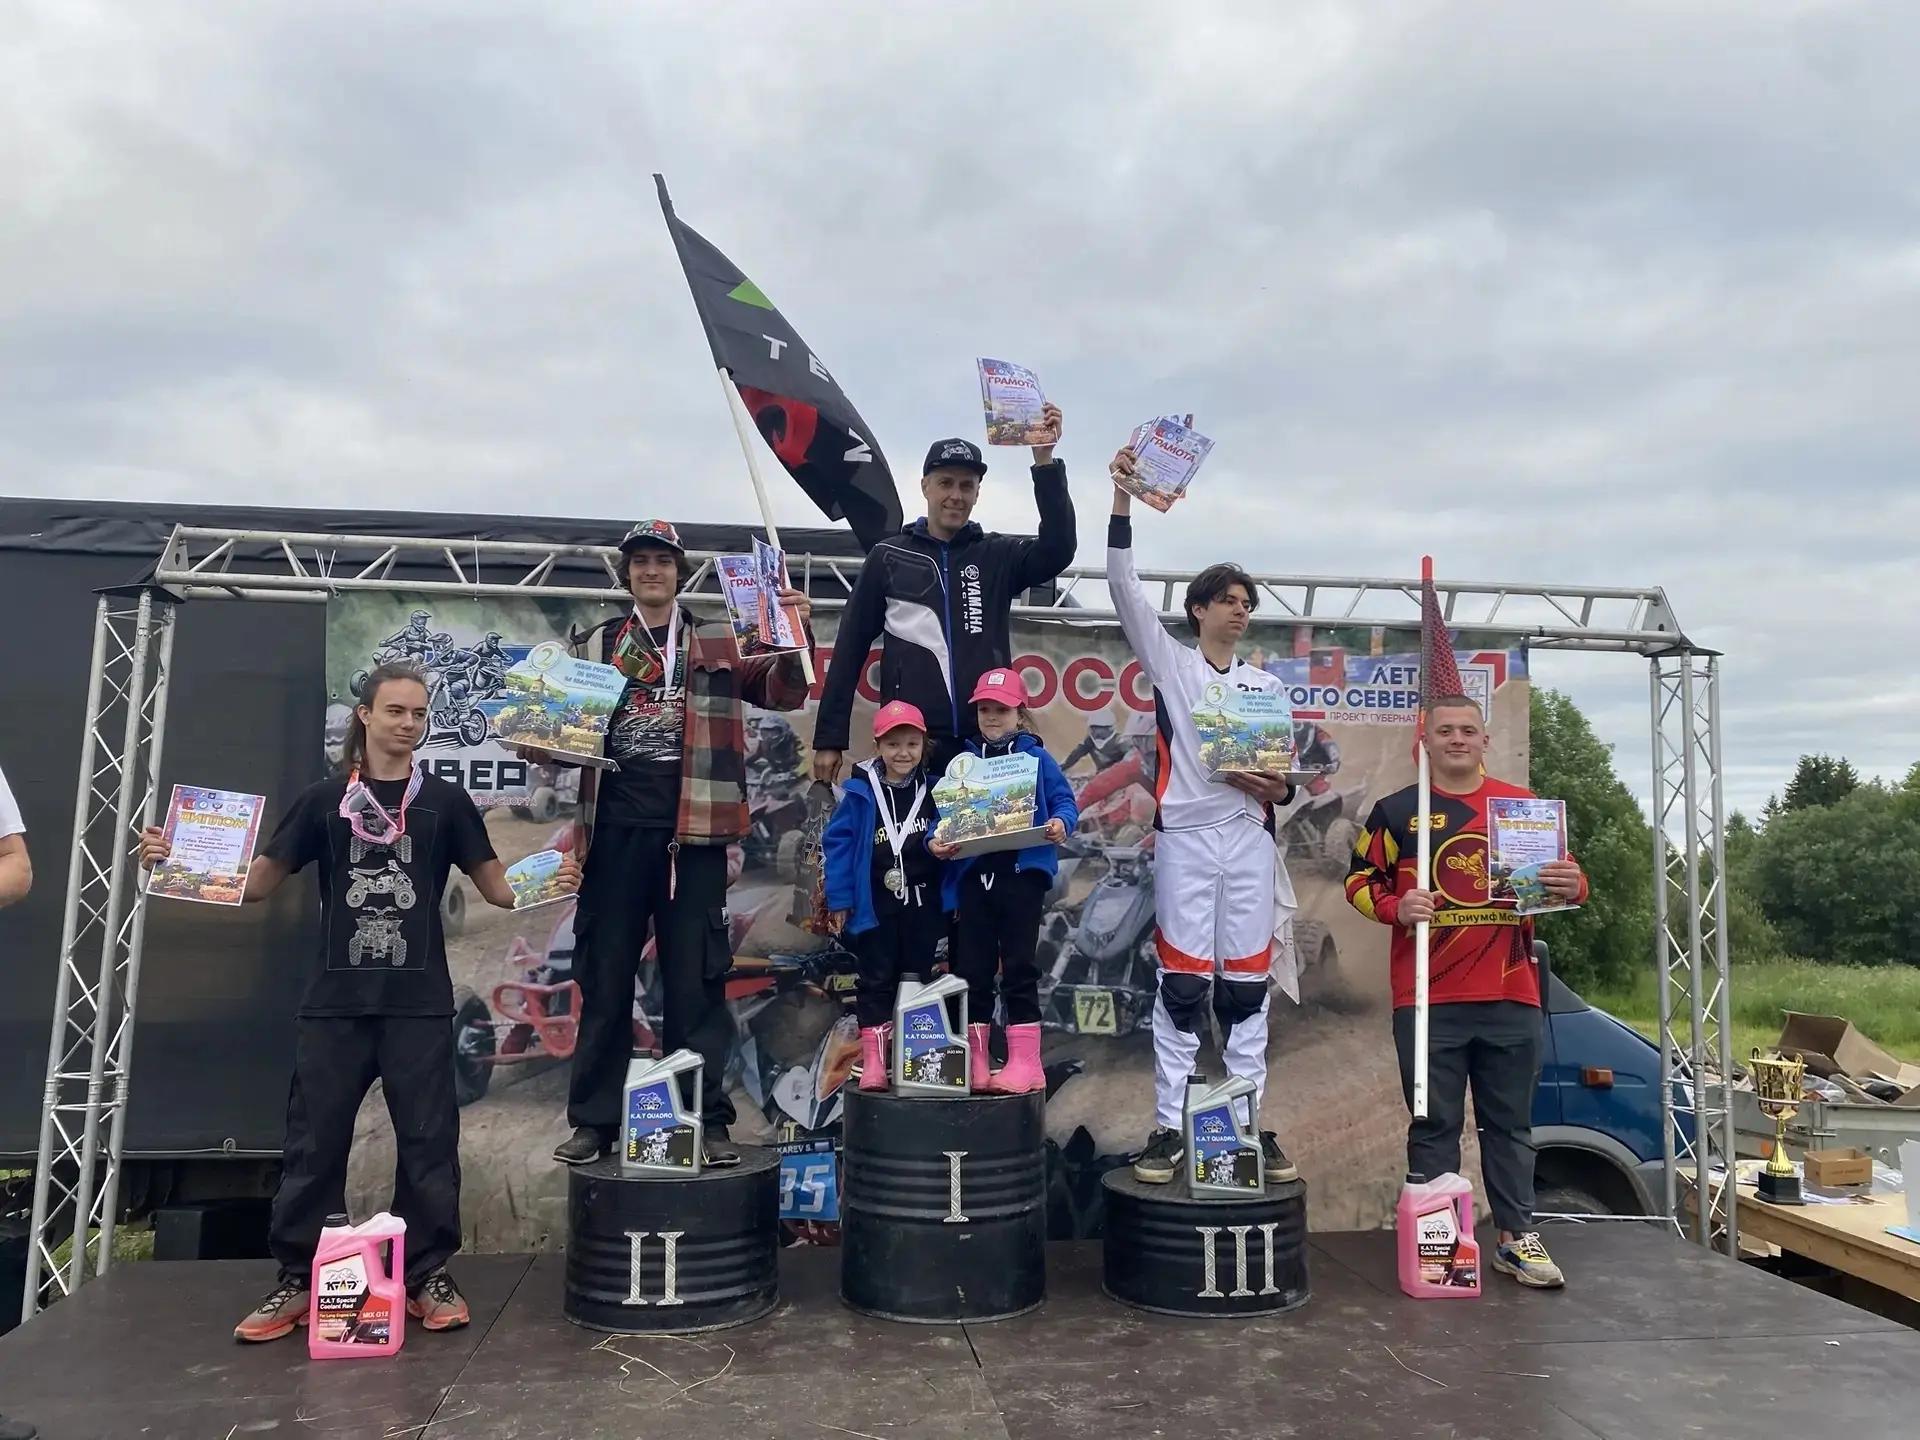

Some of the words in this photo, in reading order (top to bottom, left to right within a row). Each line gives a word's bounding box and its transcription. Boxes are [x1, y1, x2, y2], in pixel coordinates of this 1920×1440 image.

[988, 377, 1037, 389] ГРАМОТА
[1150, 437, 1196, 462] ГРАМОТА
[730, 578, 757, 588] ГРАМ
[960, 570, 969, 630] RACING
[967, 581, 982, 634] YAMAHA
[537, 648, 554, 666] 2
[1372, 667, 1419, 685] ЛЕТ
[652, 686, 685, 701] TEA
[1210, 686, 1222, 702] 3
[1285, 687, 1340, 706] ОГО
[1346, 689, 1420, 708] СЕВЕР
[1330, 711, 1365, 721] ПРОЕКТ
[1370, 712, 1418, 723] ГУБЕРНАТ
[419, 759, 526, 790] ВЕР
[957, 758, 965, 776] 1
[180, 811, 249, 829] ДИПЛОМ
[1409, 814, 1446, 832] 93
[1081, 994, 1111, 1026] 72
[629, 1127, 637, 1158] 10W-40
[775, 1144, 804, 1154] KAREV
[1197, 1149, 1205, 1179] 10W-40
[942, 1151, 969, 1222] I
[621, 1230, 685, 1306] II
[1195, 1222, 1281, 1298] III
